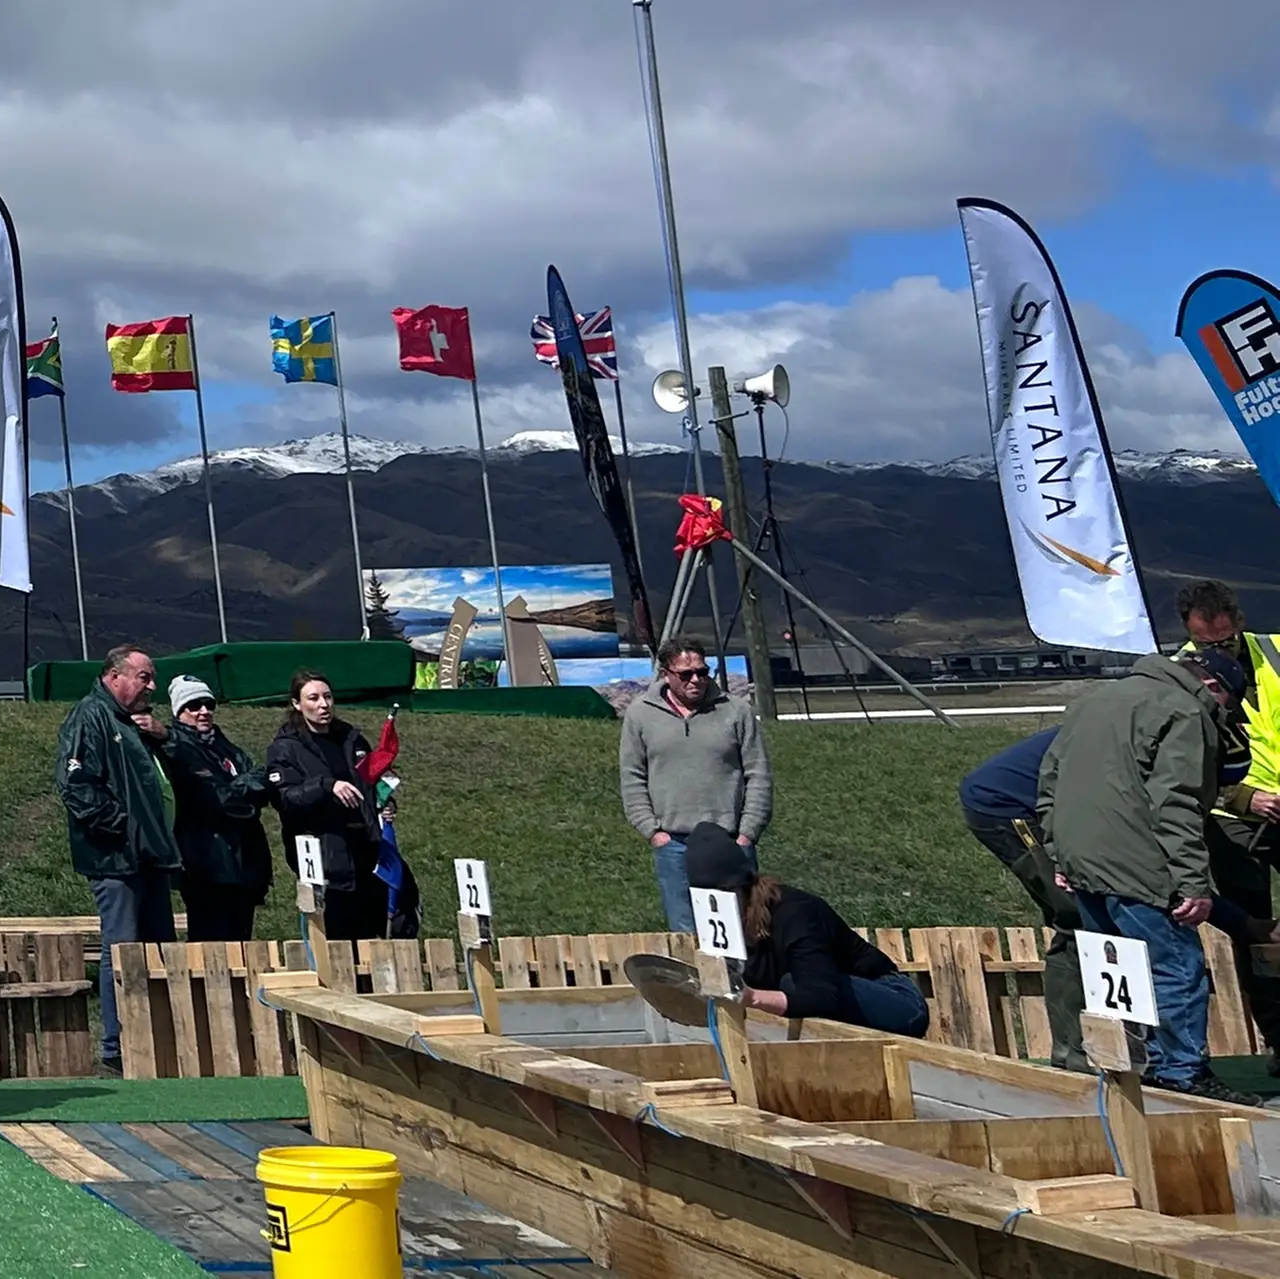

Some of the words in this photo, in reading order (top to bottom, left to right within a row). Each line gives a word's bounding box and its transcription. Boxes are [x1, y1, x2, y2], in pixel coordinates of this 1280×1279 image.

[1011, 301, 1077, 522] SANTANA
[1007, 427, 1028, 493] LIMITED
[305, 858, 316, 879] 21
[466, 884, 480, 908] 22
[708, 919, 728, 949] 23
[1100, 972, 1132, 1012] 24
